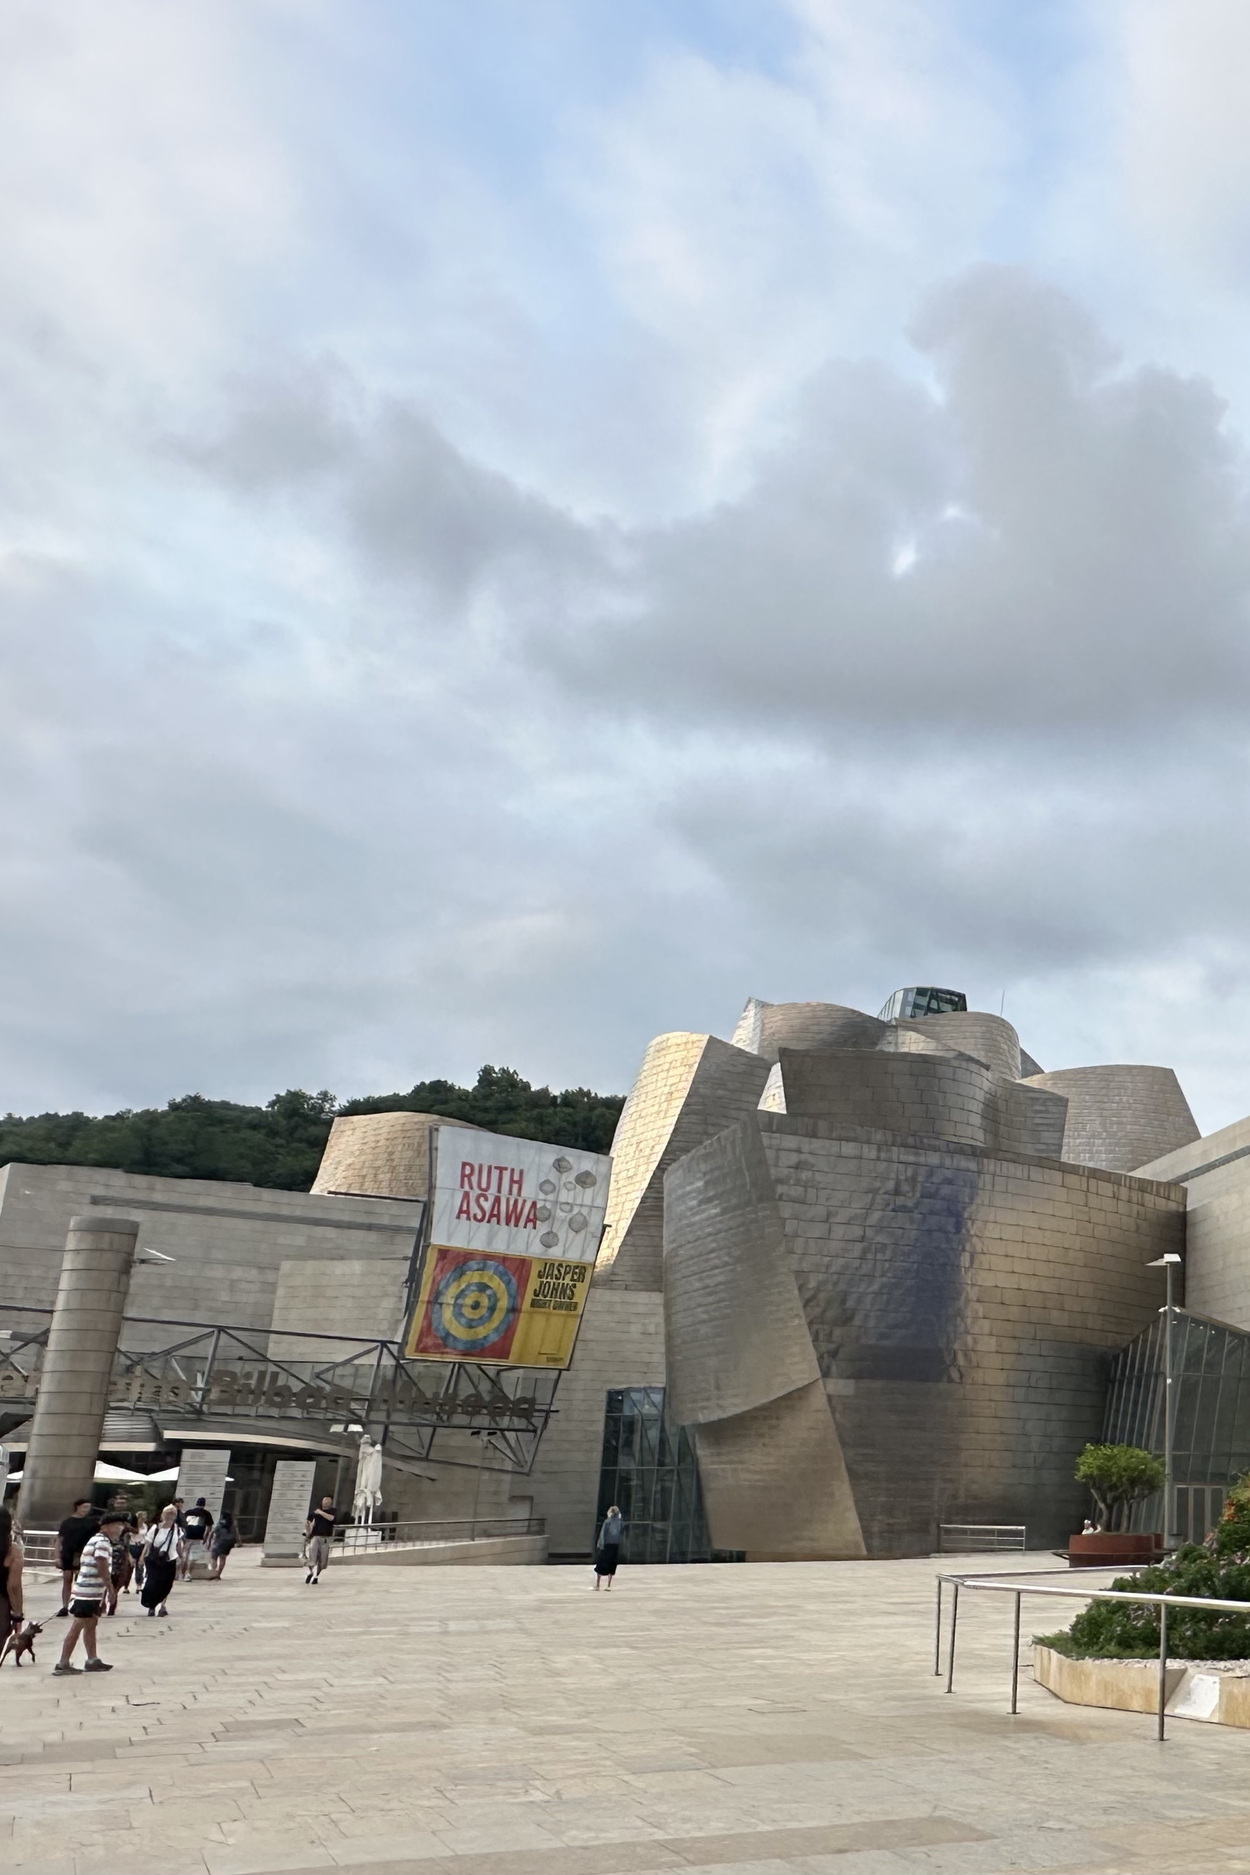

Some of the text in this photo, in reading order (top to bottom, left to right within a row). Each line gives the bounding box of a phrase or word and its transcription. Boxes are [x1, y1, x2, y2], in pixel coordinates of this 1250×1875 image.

[460, 1161, 524, 1197] RUTH
[455, 1191, 538, 1230] ASAWA
[537, 1262, 587, 1283] JASPER
[533, 1280, 577, 1300] JOHNS
